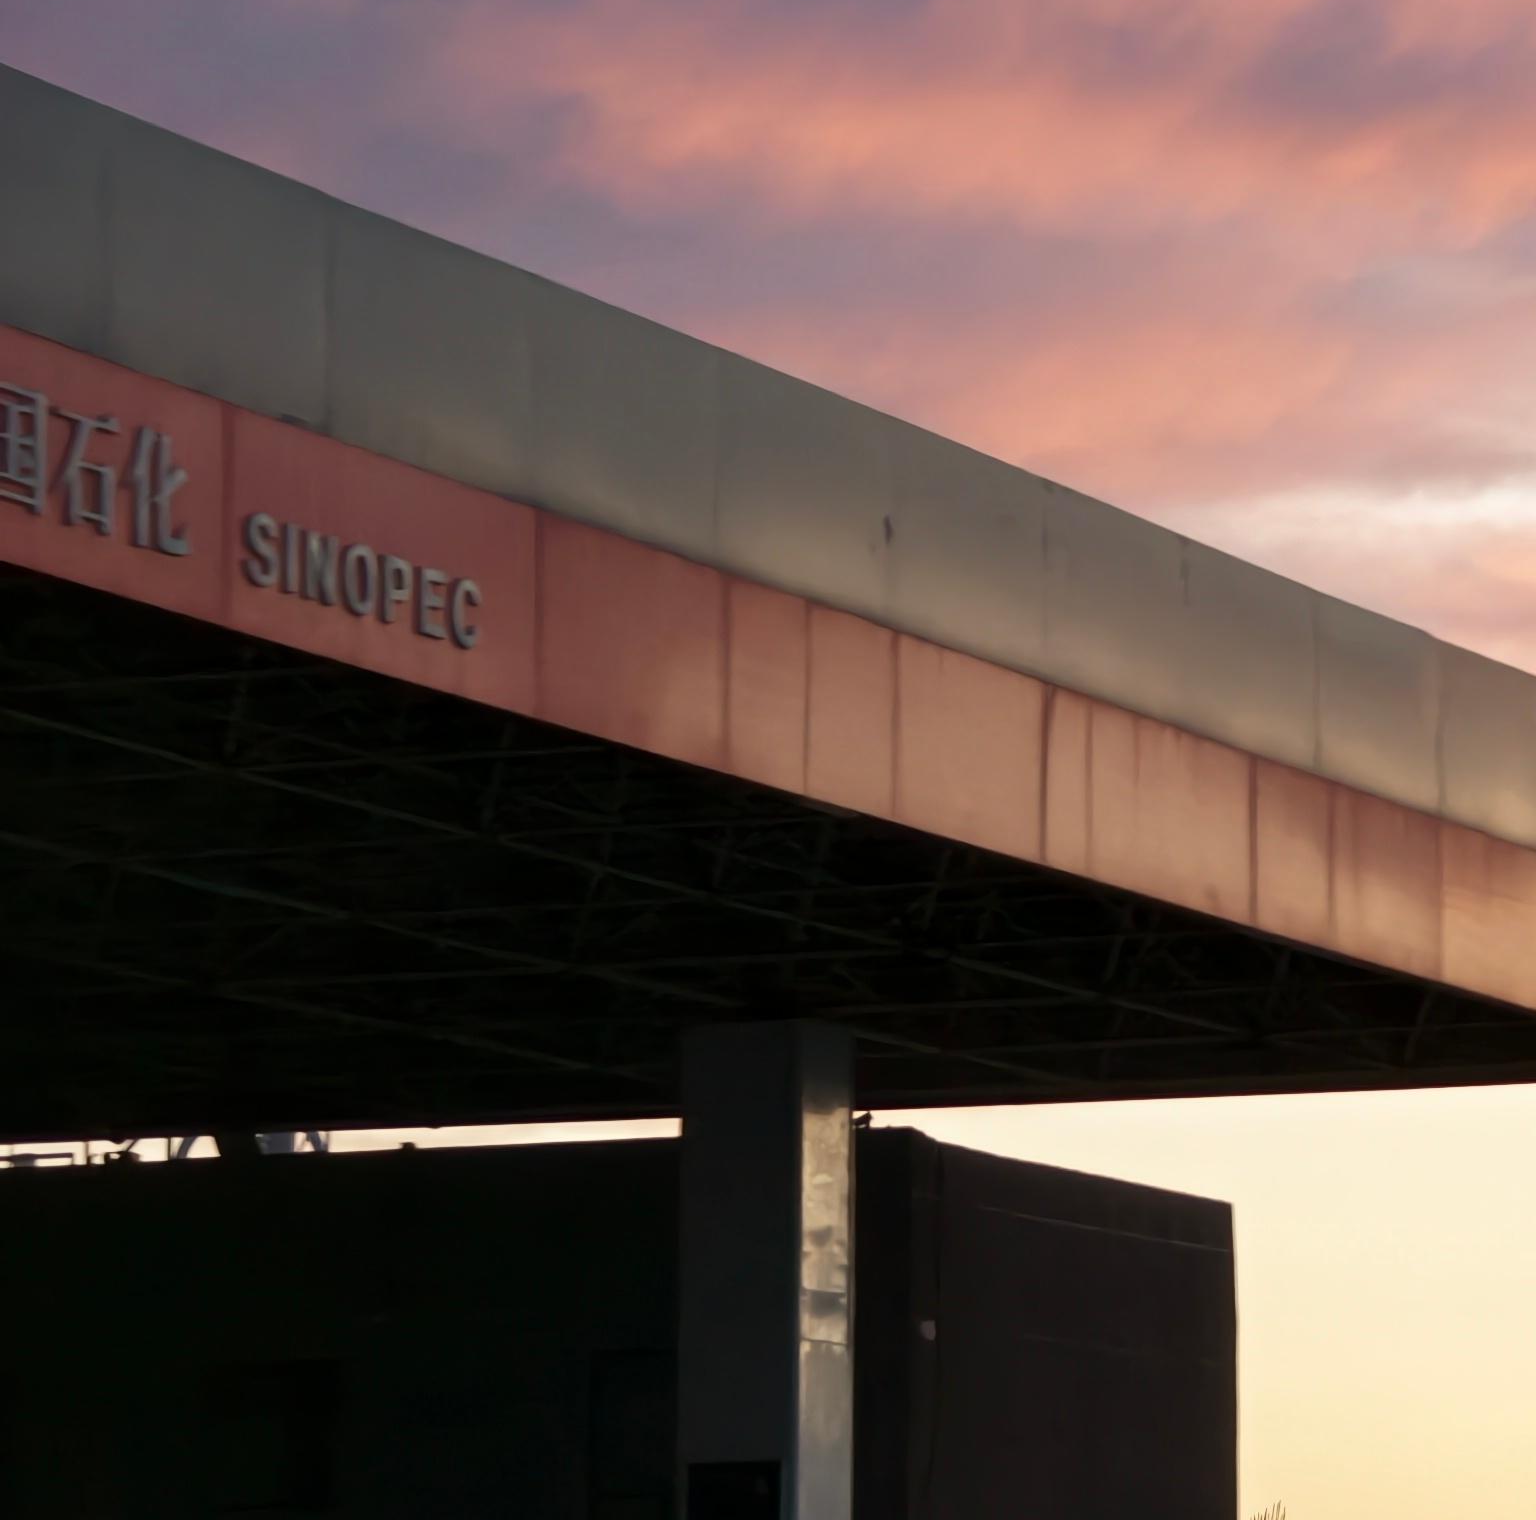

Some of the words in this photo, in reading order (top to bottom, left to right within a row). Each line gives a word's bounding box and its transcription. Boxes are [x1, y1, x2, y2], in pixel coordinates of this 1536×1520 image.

[0, 384, 190, 556] 国石化
[244, 512, 482, 649] SINOPEC
